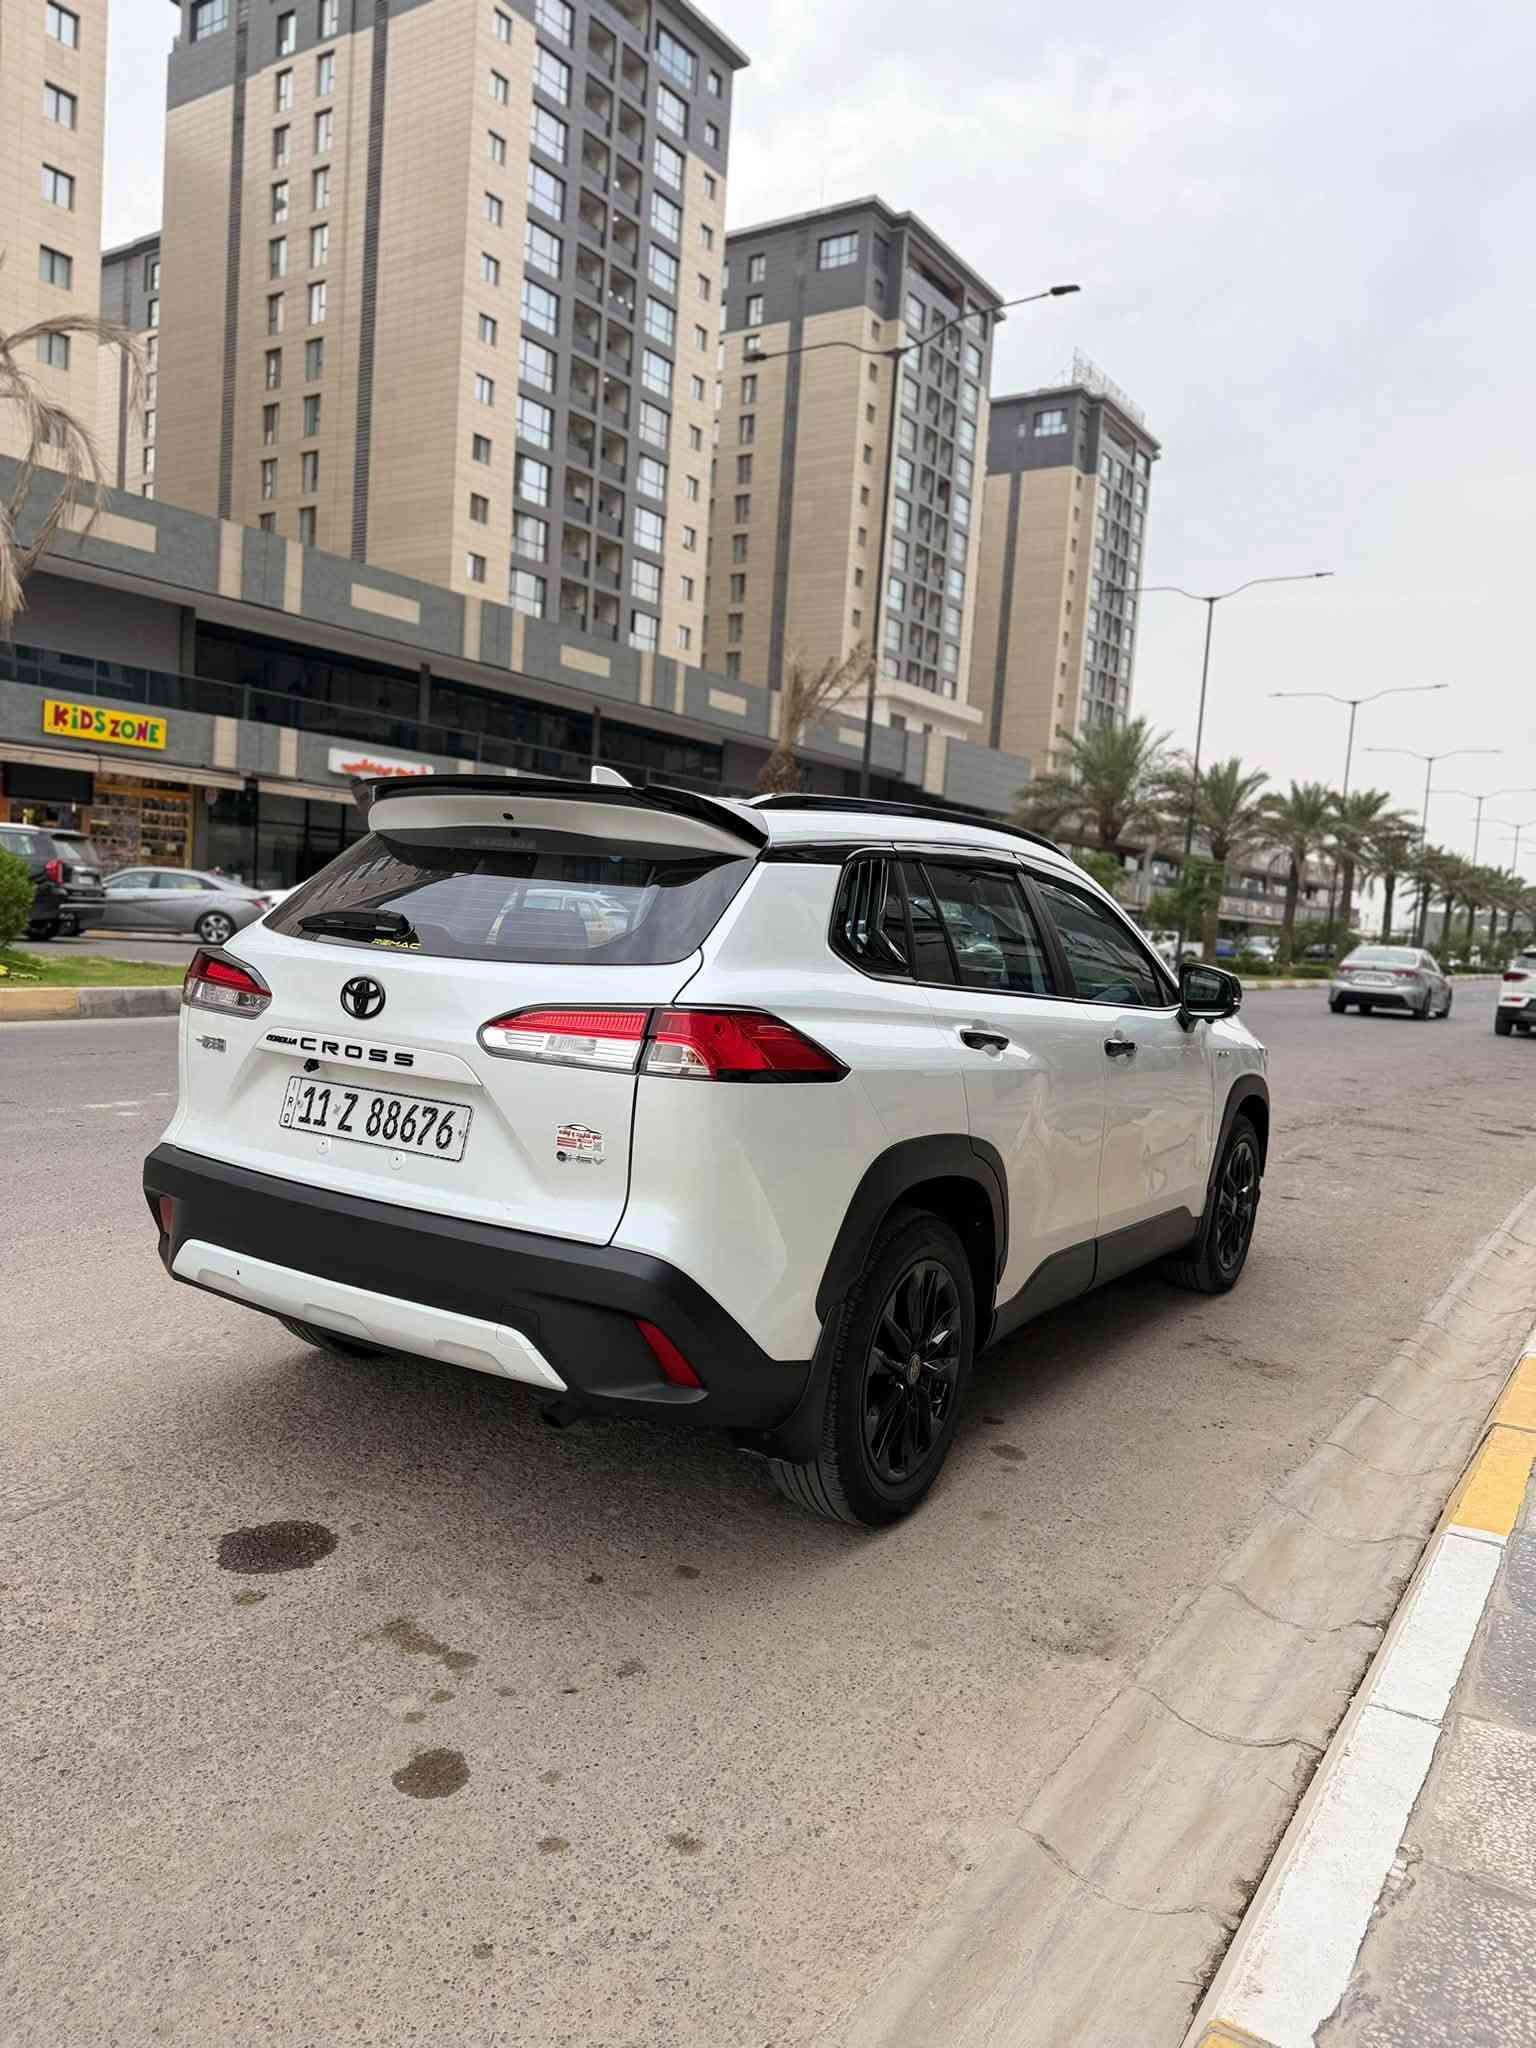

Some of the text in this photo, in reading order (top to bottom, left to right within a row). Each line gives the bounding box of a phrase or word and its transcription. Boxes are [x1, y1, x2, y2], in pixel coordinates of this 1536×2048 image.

[110, 719, 160, 744] ZONE
[300, 1037, 414, 1067] CROSS
[298, 1086, 456, 1149] 11 Z 88676
